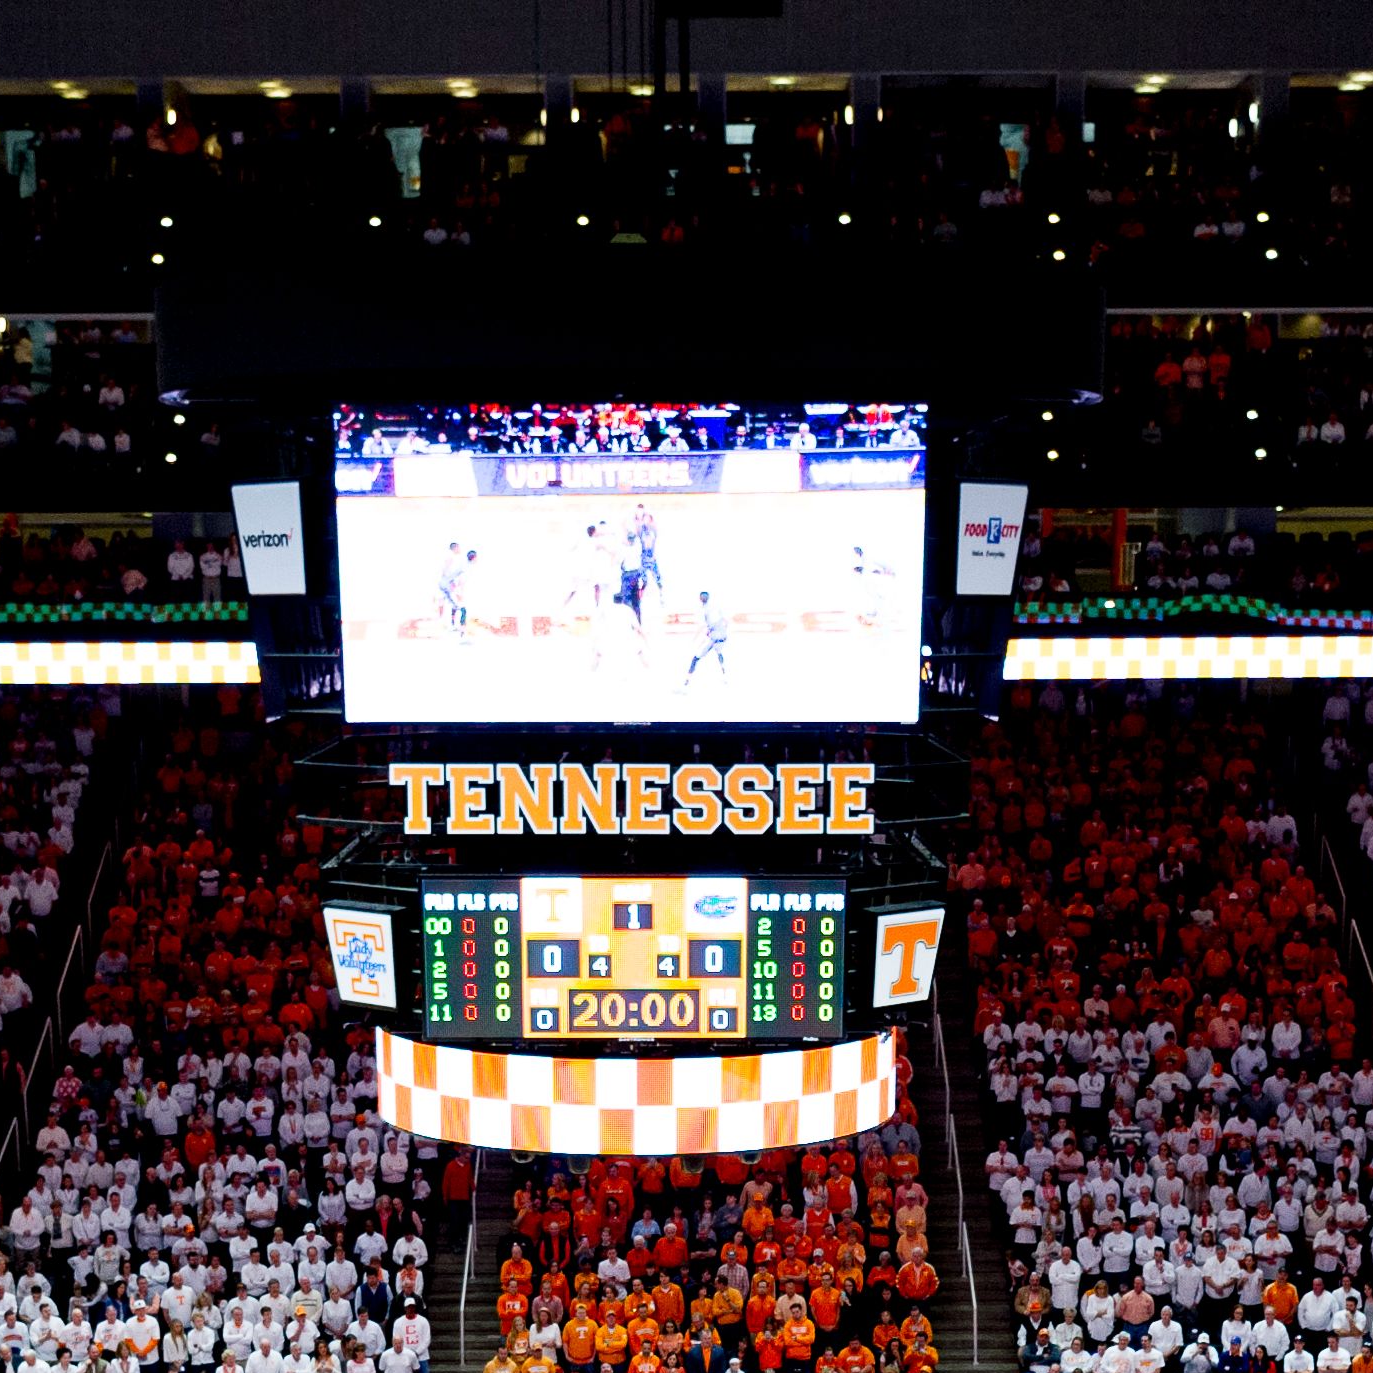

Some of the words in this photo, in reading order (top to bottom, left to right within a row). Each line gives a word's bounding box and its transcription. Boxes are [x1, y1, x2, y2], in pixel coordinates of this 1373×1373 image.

[243, 530, 289, 548] verizon
[964, 523, 988, 537] FOOD
[1001, 524, 1020, 538] CITY
[341, 610, 912, 641] TENNSSEE
[389, 763, 875, 835] TENNESSEE
[627, 904, 640, 929] 1
[425, 917, 452, 935] 00
[462, 918, 475, 934] 0
[494, 917, 509, 935] 0
[757, 917, 772, 935] 2
[793, 918, 806, 934] 0
[820, 917, 834, 935] 0
[434, 939, 444, 957] 1
[463, 940, 476, 956] 0
[494, 939, 509, 957] 0
[757, 939, 772, 957] 5
[792, 940, 806, 956] 0
[820, 939, 834, 957] 0
[543, 945, 562, 973] 0
[592, 957, 608, 977] 4
[658, 957, 674, 977] 4
[704, 945, 723, 973] 0
[882, 919, 940, 998] T
[432, 961, 447, 978] 2
[463, 962, 476, 977] 0
[495, 961, 510, 978] 0
[753, 961, 777, 978] 10
[792, 961, 806, 978] 0
[819, 961, 834, 978] 0
[433, 983, 448, 1000] 5
[464, 983, 477, 999] 0
[495, 983, 510, 1000] 0
[753, 983, 774, 1000] 11
[792, 983, 806, 999] 0
[819, 982, 833, 1000] 0
[430, 1004, 452, 1022] 11
[464, 1005, 478, 1021] 0
[496, 1004, 511, 1022] 0
[573, 993, 695, 1027] 20:00
[752, 1004, 777, 1022] 13
[792, 1004, 805, 1021] 0
[819, 1004, 833, 1022] 0
[536, 1010, 553, 1029] 0
[712, 1010, 729, 1029] 0
